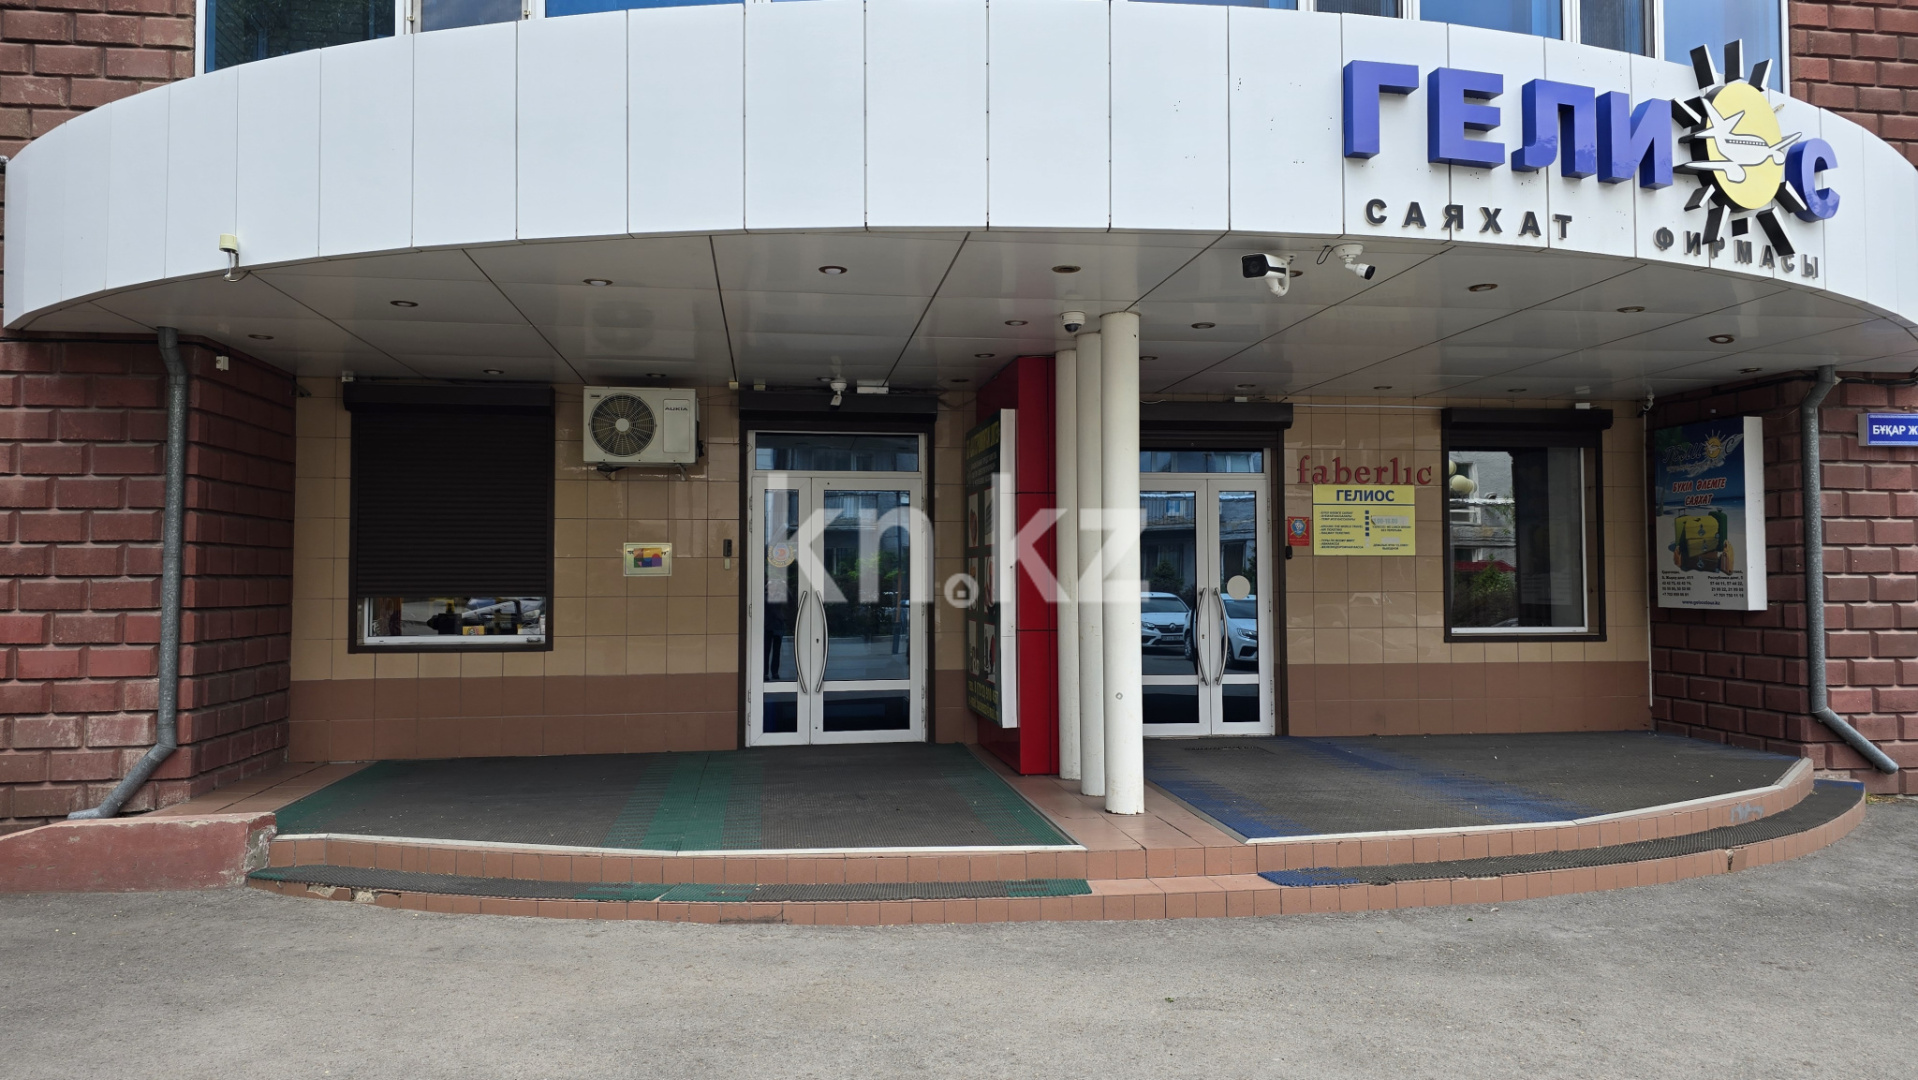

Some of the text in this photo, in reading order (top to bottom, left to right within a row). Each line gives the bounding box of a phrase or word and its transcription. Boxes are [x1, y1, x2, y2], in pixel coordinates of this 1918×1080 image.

[1365, 198, 1819, 279] САЯХАТ ФИРМАСЫ
[1872, 425, 1906, 437] БҰҚАР
[1696, 477, 1727, 491] ӘЛЕМГЕ
[1336, 489, 1395, 502] ГЕЛИОС
[1685, 494, 1713, 506] САЯХАТ
